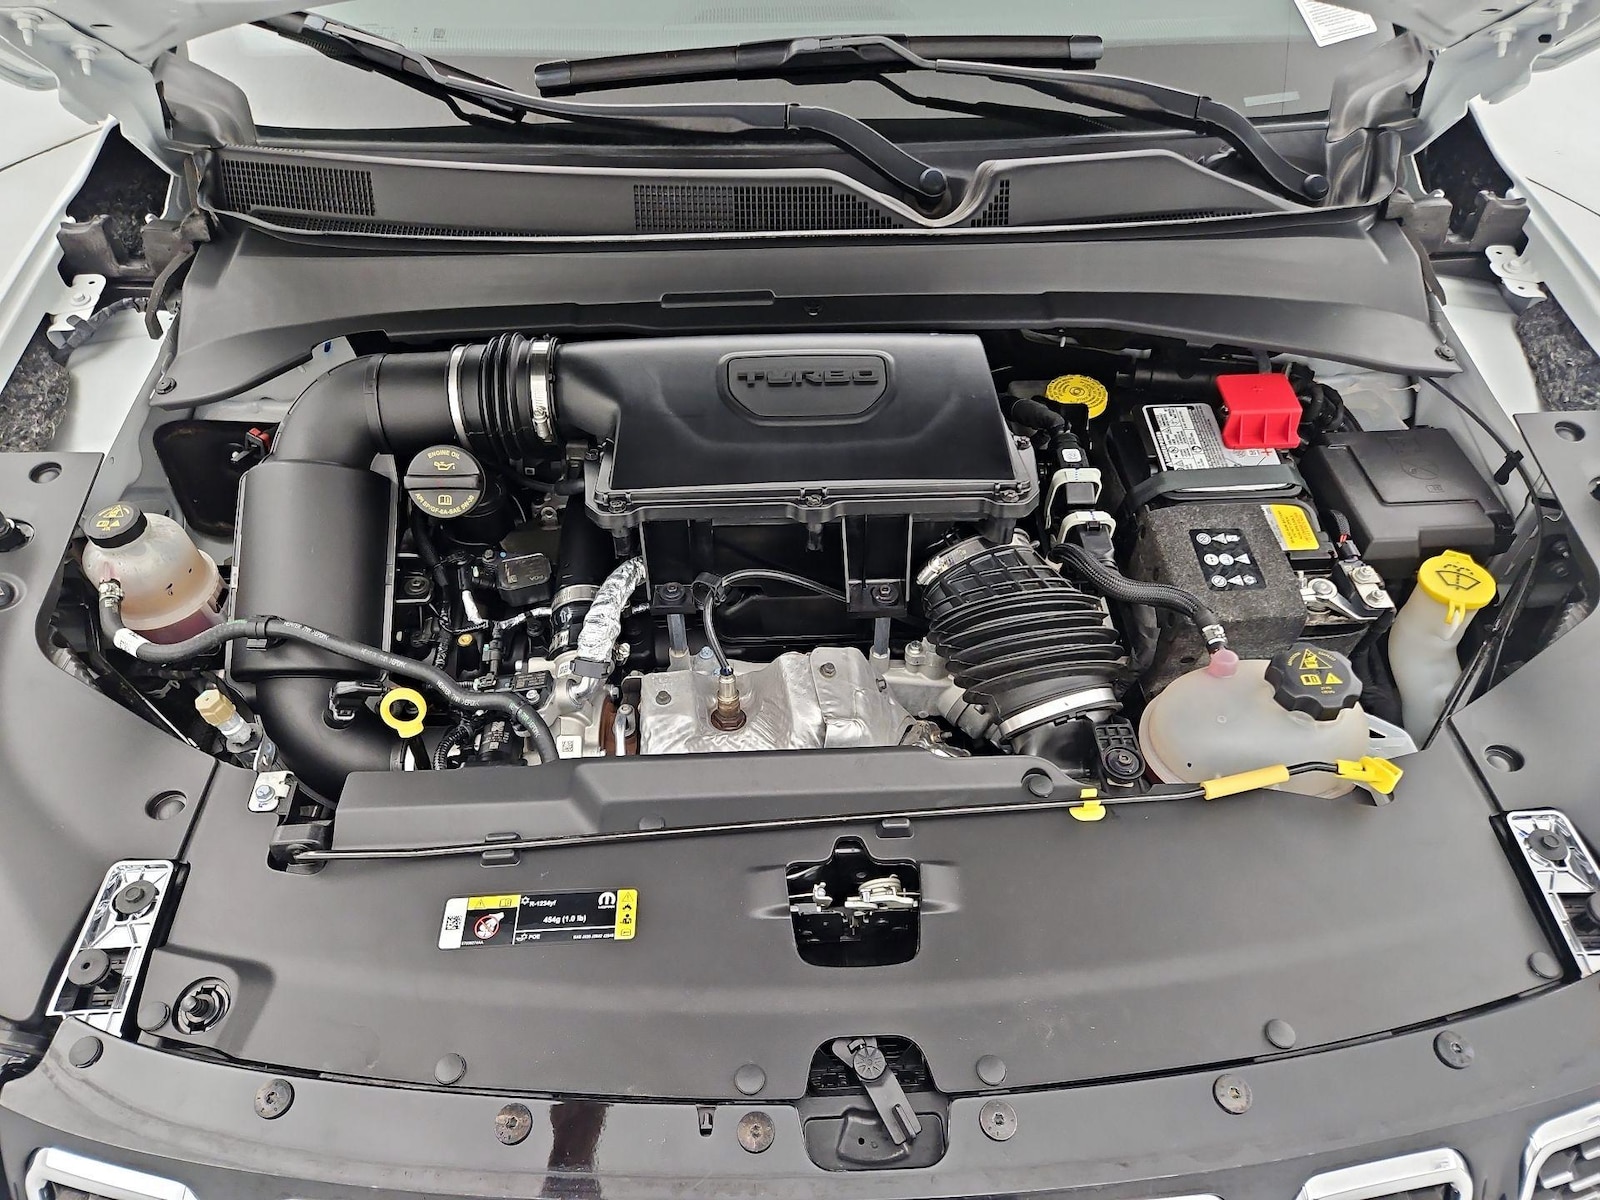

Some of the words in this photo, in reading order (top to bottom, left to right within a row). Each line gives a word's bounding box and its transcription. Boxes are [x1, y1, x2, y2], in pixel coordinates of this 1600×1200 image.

[737, 370, 879, 388] TURBO
[427, 449, 451, 459] ENGINE
[450, 450, 461, 460] OIL
[543, 916, 561, 924] 454g
[562, 915, 576, 924] (1.0
[576, 914, 587, 923] lb)
